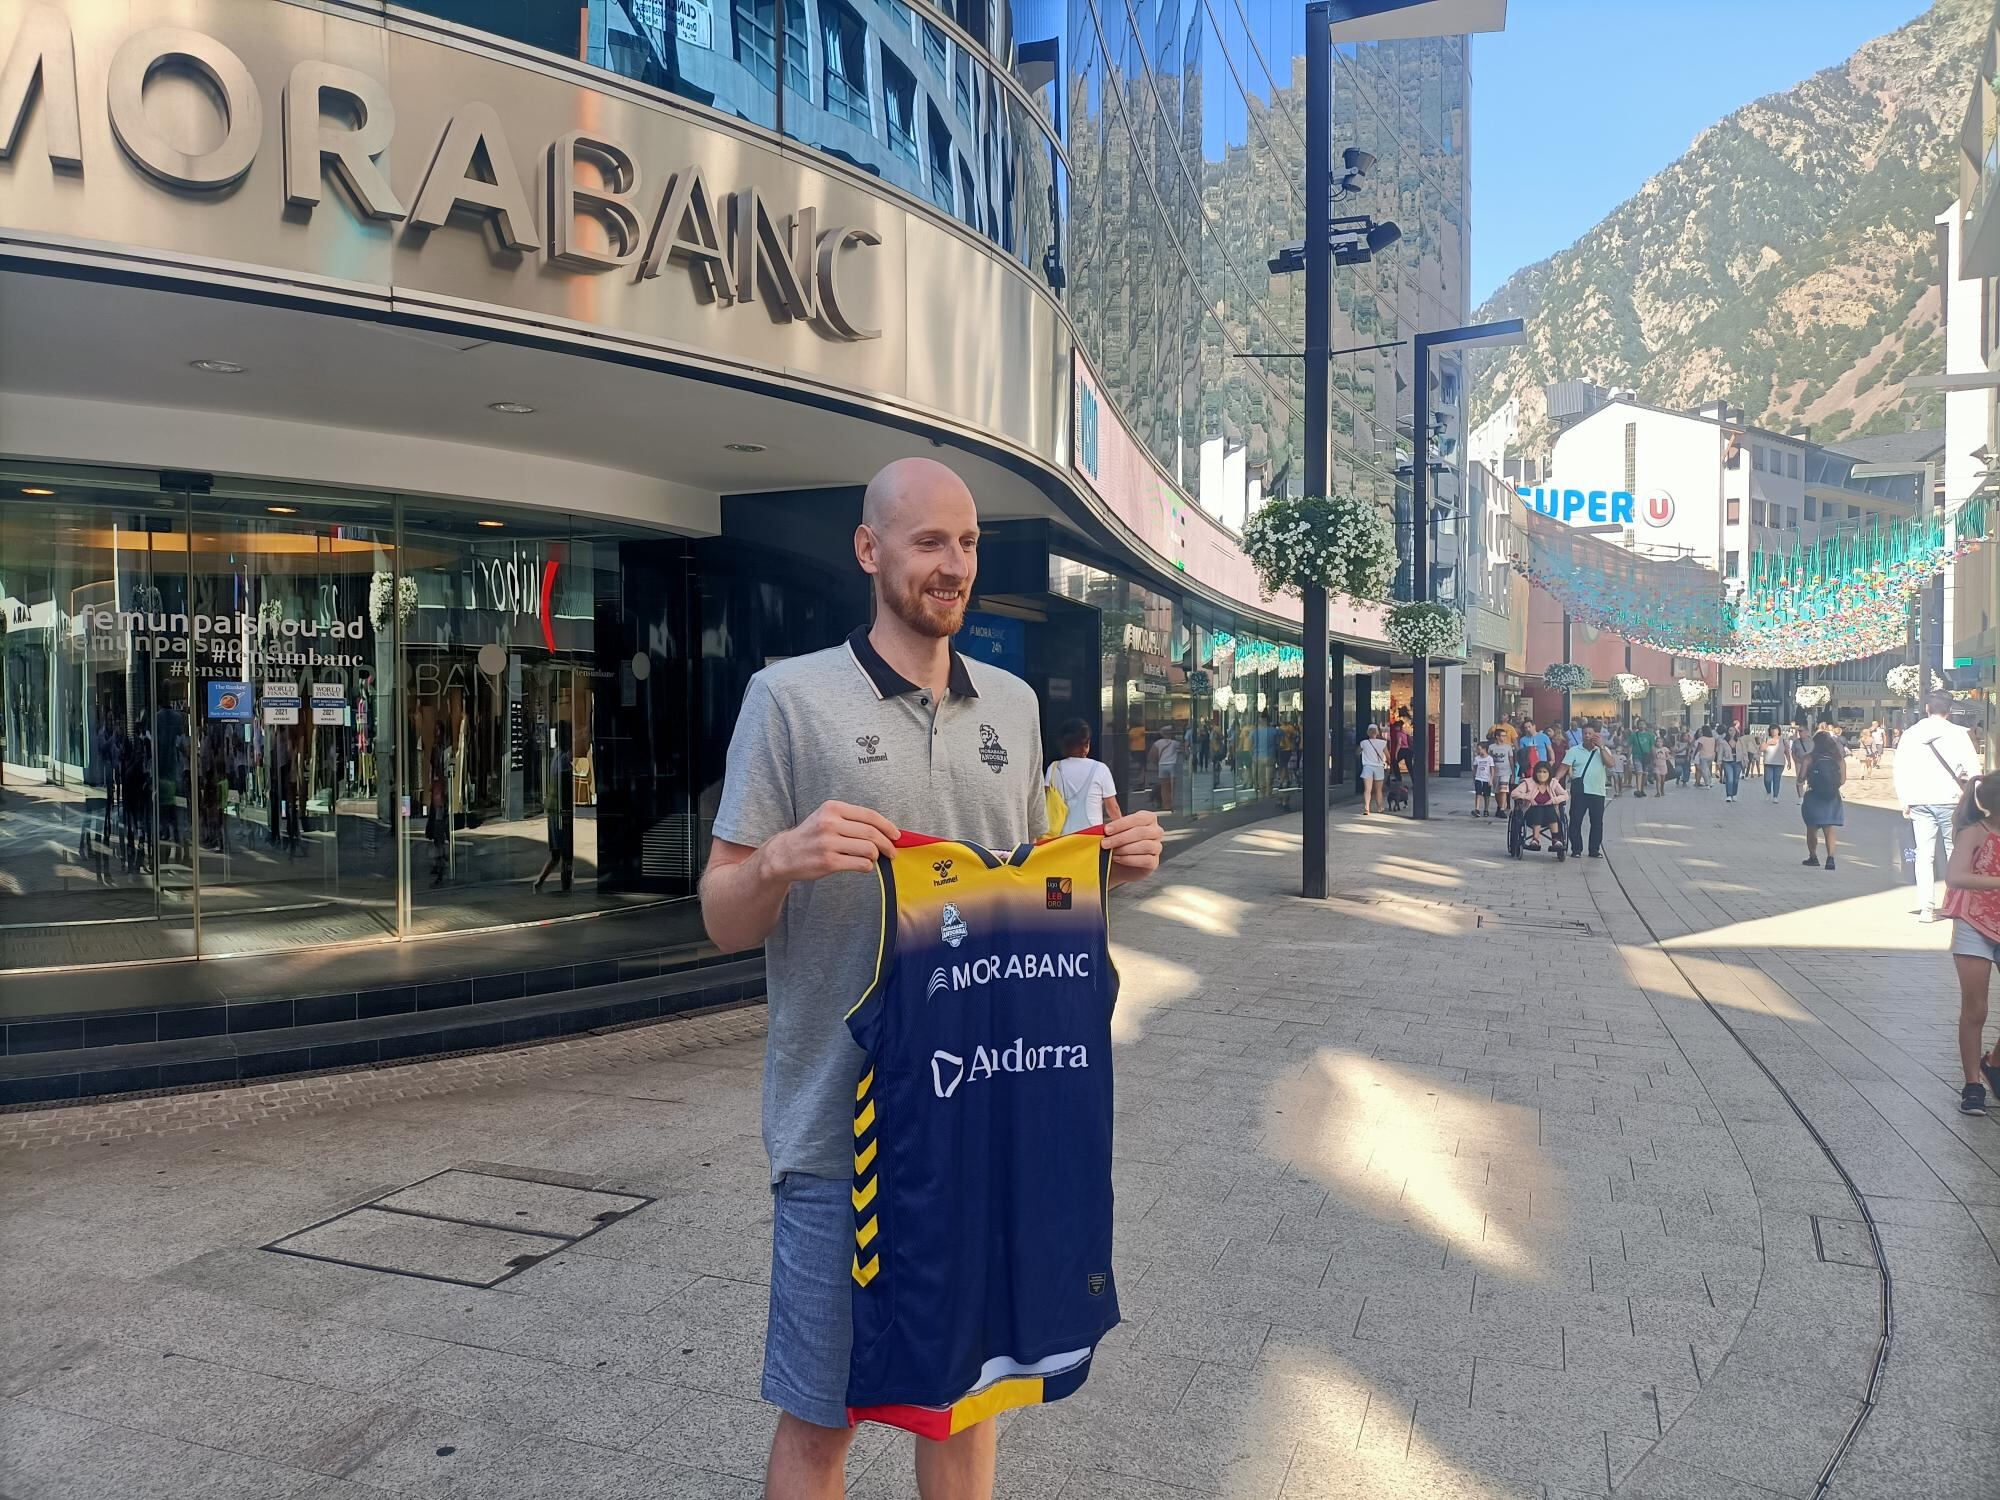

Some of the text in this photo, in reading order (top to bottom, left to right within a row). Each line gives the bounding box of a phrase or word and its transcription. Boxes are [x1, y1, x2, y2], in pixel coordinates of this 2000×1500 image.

[1649, 498, 1669, 520] U
[858, 753, 888, 765] hummel
[933, 875, 959, 887] hummel
[1048, 892, 1062, 900] LEB
[952, 953, 1089, 991] MORABANC
